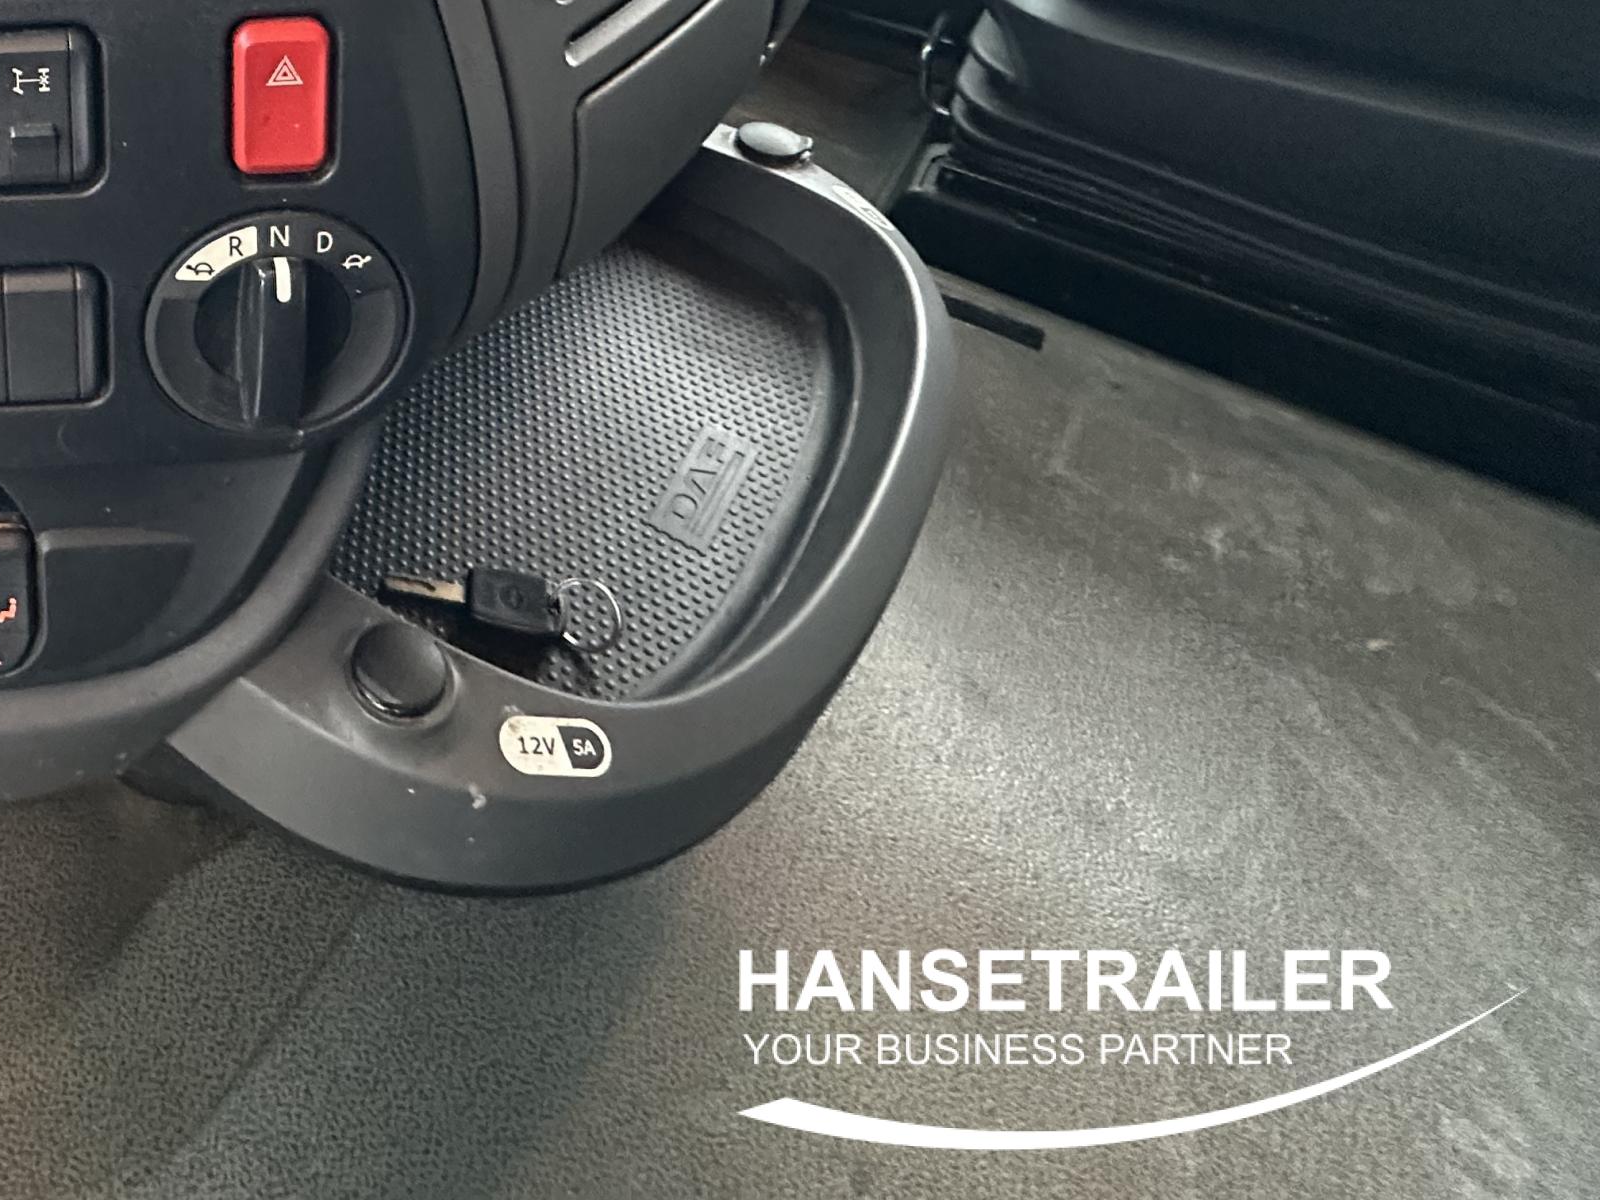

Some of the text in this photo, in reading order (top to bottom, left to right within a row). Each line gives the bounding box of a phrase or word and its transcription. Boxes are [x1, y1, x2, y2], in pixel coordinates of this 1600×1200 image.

[228, 224, 334, 257] R N D
[518, 735, 597, 757] 12V 5A
